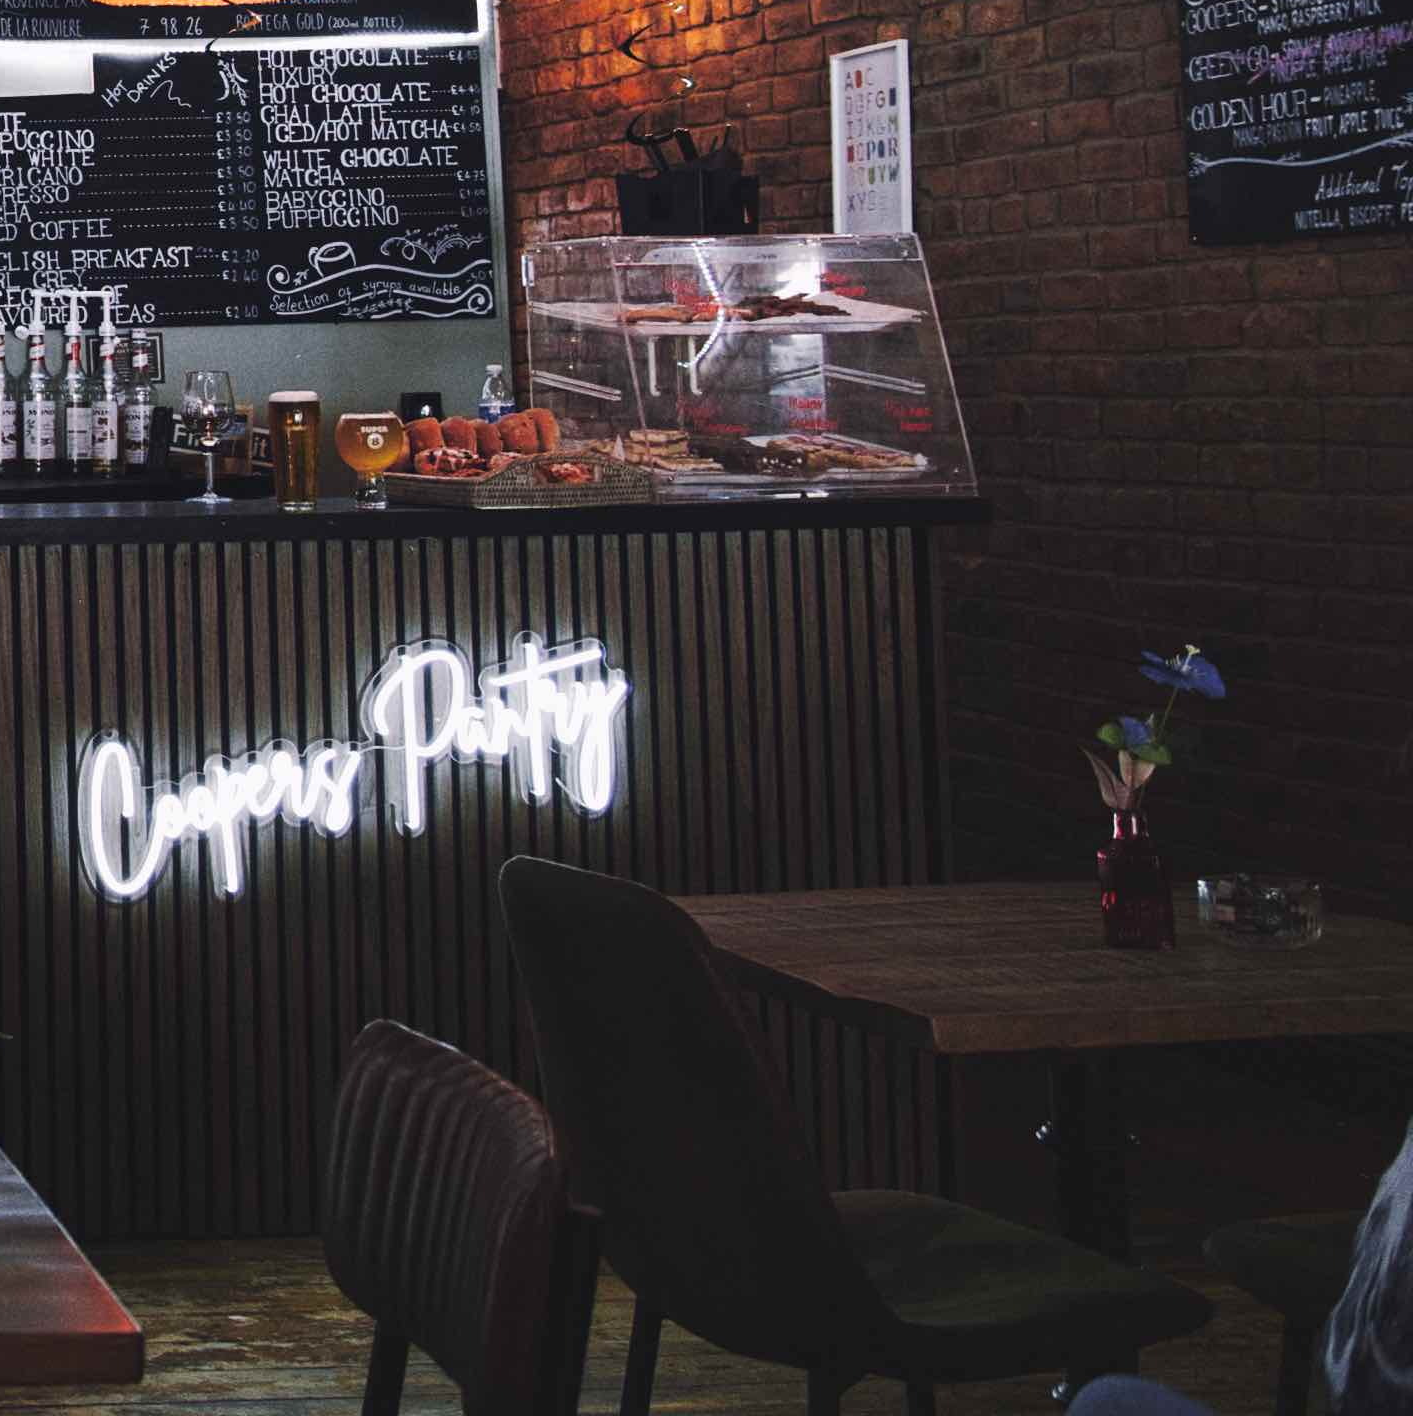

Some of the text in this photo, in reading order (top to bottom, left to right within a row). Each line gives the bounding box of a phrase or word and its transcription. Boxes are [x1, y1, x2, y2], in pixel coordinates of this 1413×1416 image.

[0, 18, 12, 36] DE
[297, 13, 323, 30] GOLD
[258, 48, 429, 68] HOT CHOCOLATE
[127, 53, 178, 104] DRINKS
[259, 66, 338, 86] LUXURY
[101, 80, 129, 108] HOT
[259, 83, 431, 104] HOT CHOCOLATE
[260, 103, 392, 125] CHAI LATTE
[1190, 88, 1308, 131] GOLDEN HOUR
[266, 119, 451, 143] ICED/HOT MATCHA
[1339, 111, 1368, 135] APPLE
[27, 148, 95, 168] WHITE
[262, 146, 458, 169] WHITE CHOCOLATE
[263, 168, 345, 187] MATCHA
[265, 187, 385, 211] BABYCCINO
[266, 205, 399, 229] PUPPUCCINO
[30, 218, 113, 240] COFFEE
[71, 246, 194, 270] BREAKFAST
[32, 269, 86, 289] GREY
[269, 294, 330, 312] Selection
[338, 288, 352, 306] of
[362, 279, 402, 297] syrups
[409, 282, 462, 295] available
[91, 740, 361, 895] Coopers
